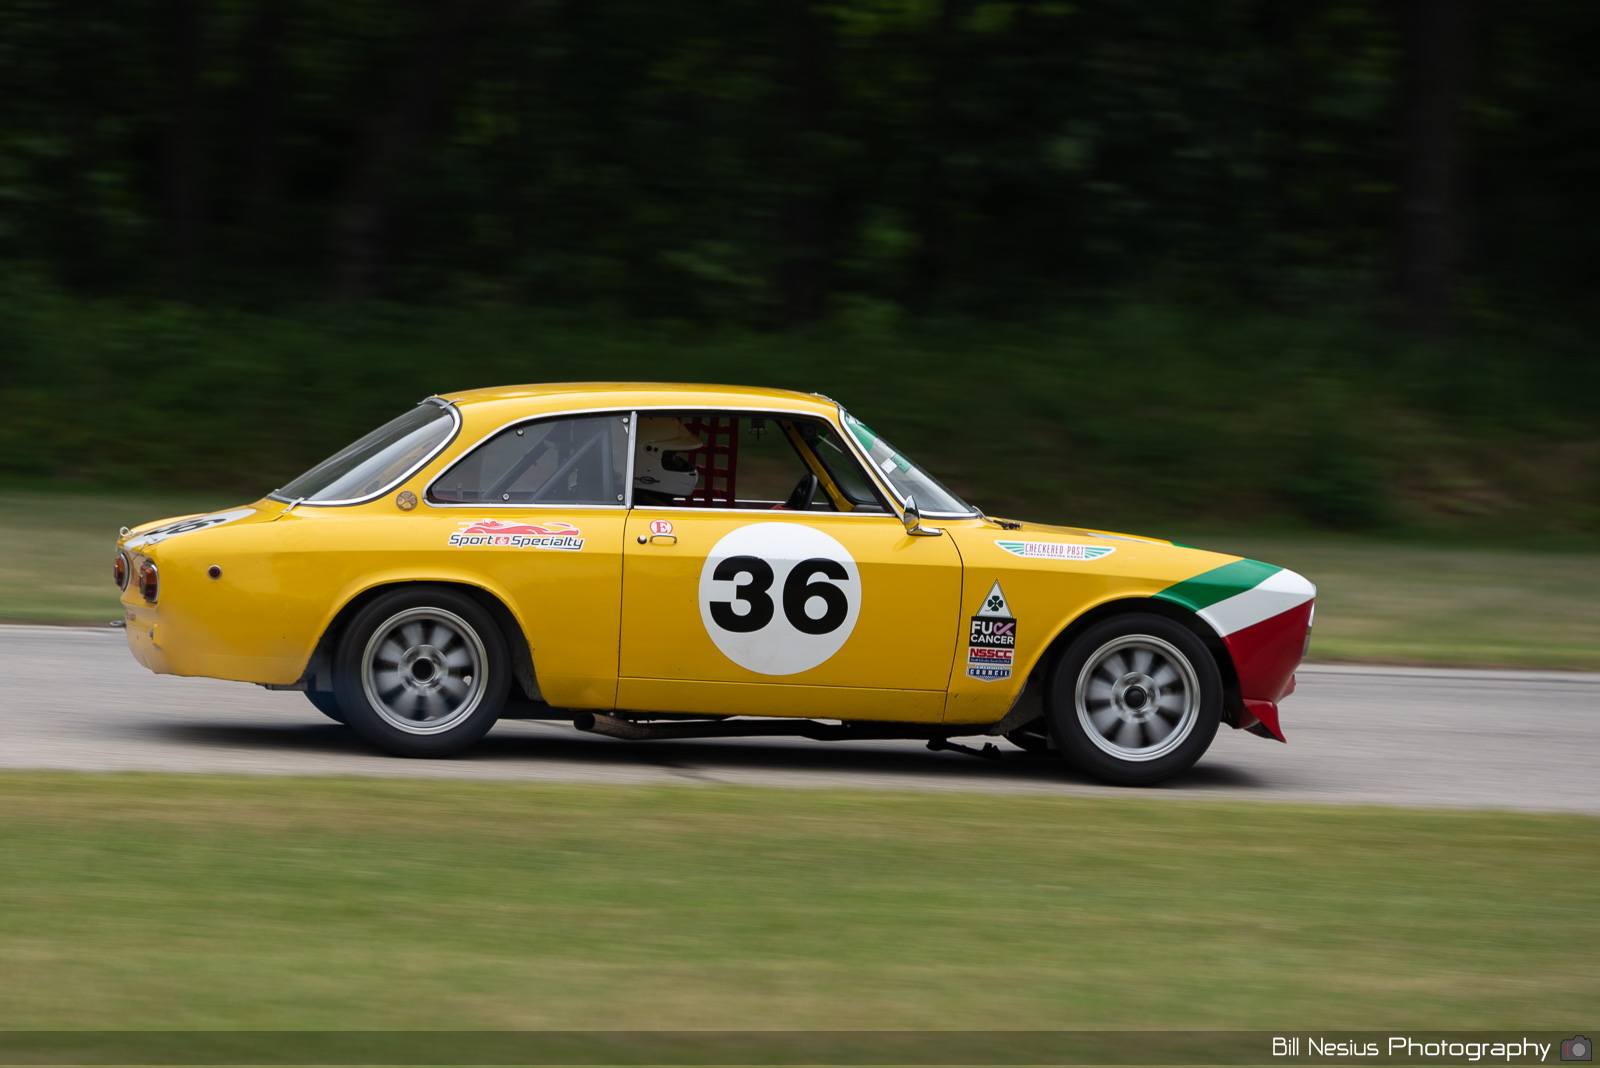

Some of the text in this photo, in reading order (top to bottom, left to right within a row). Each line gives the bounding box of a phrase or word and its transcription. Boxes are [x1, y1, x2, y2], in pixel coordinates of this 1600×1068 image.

[654, 521, 668, 533] E
[449, 534, 494, 547] Sport
[510, 535, 583, 549] Specialty
[1025, 543, 1084, 556] CHECKERED PAST
[709, 555, 850, 635] 36
[970, 634, 1014, 645] CANCER
[970, 648, 1013, 659] NSSCC
[969, 669, 1008, 677] COUNCIL
